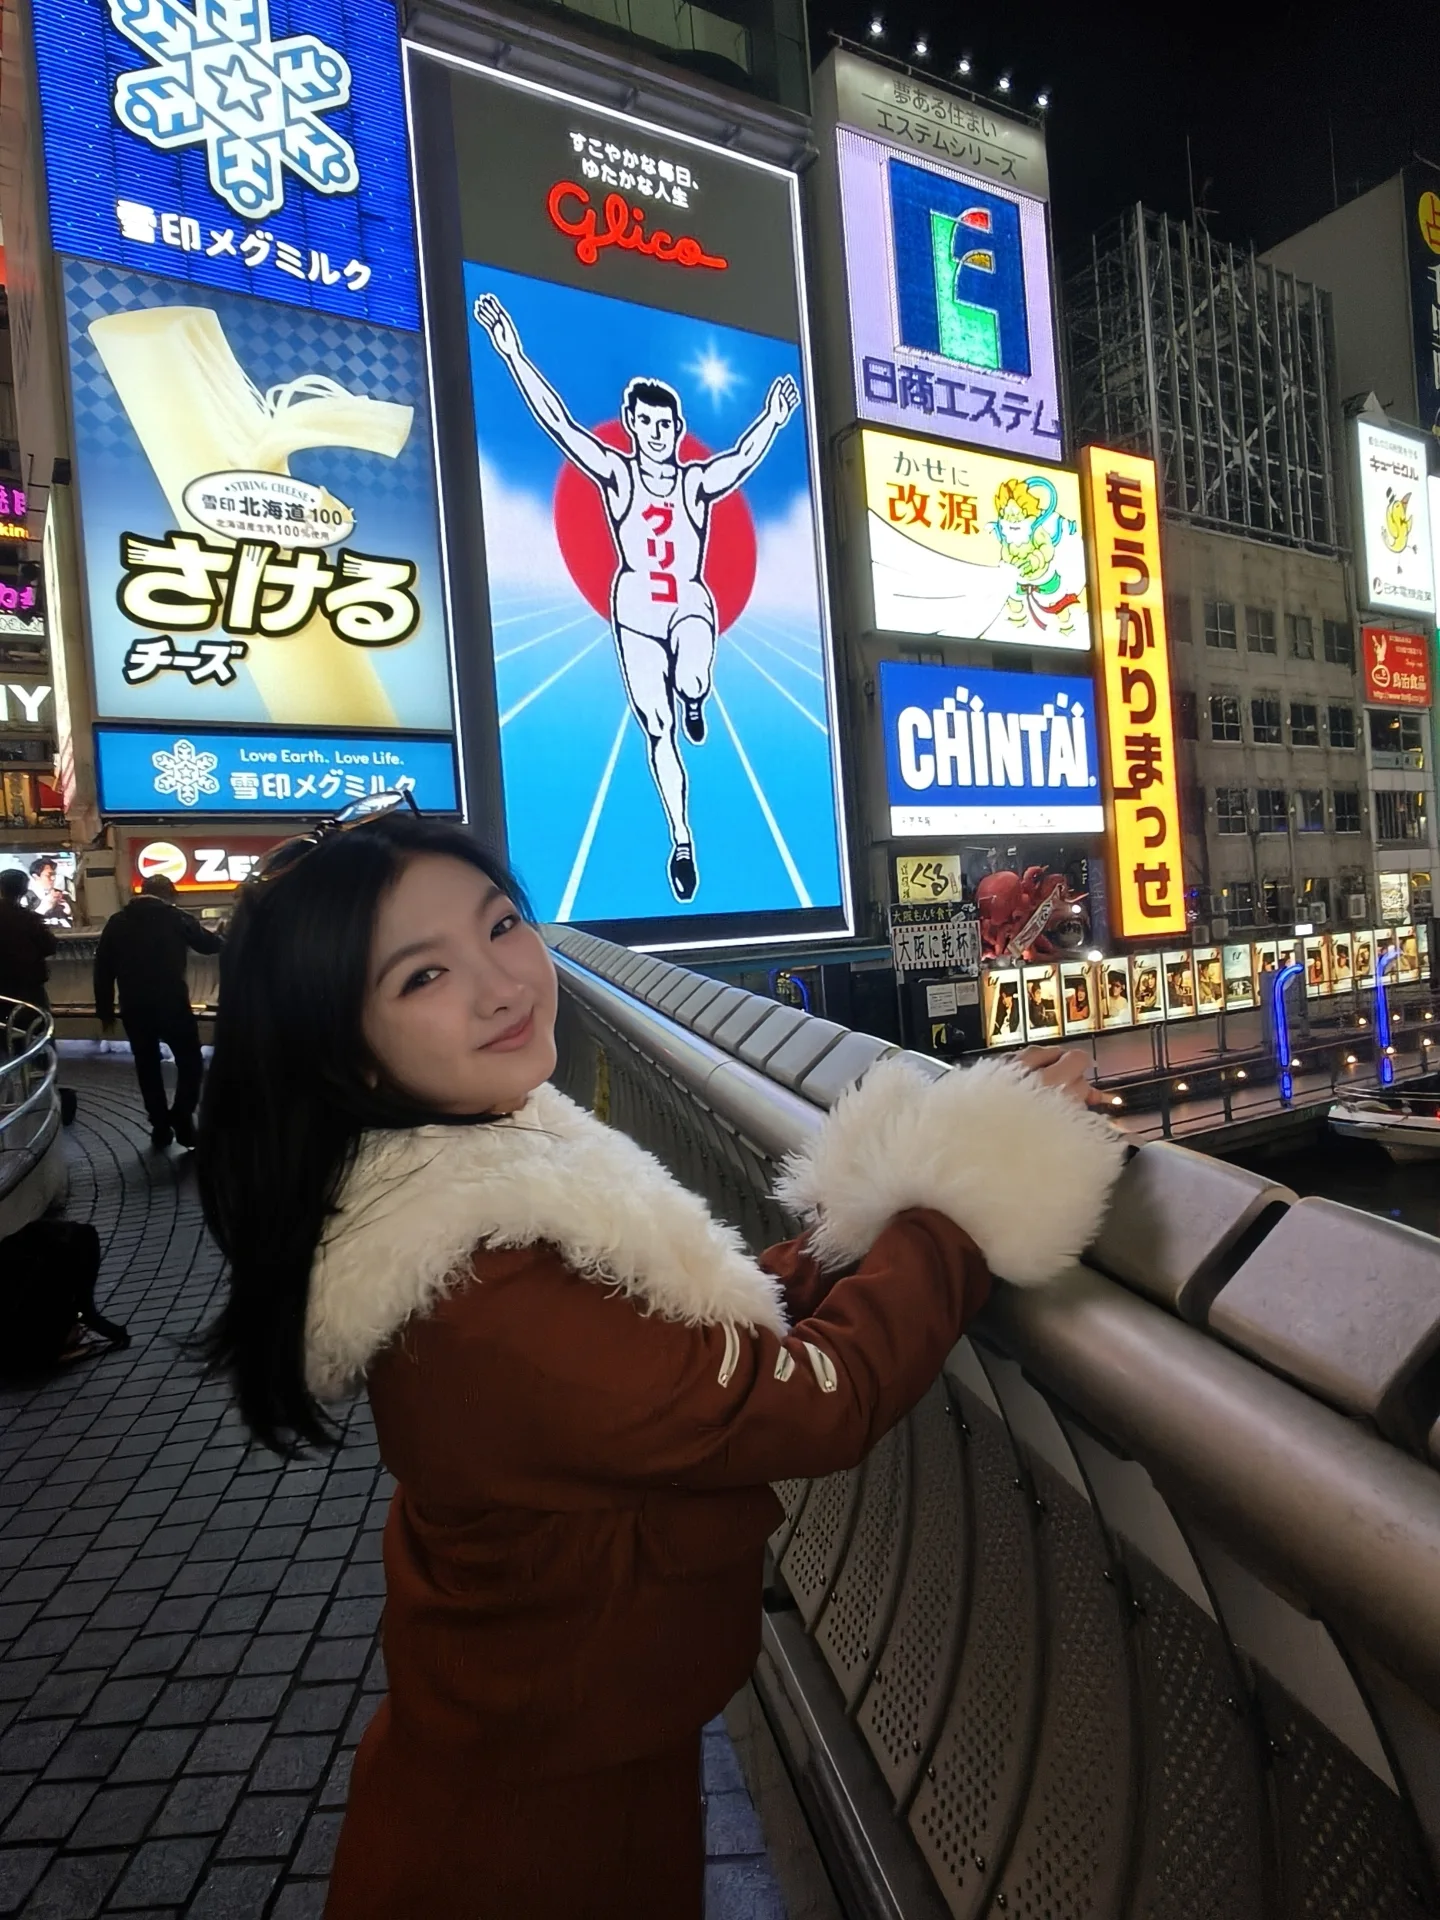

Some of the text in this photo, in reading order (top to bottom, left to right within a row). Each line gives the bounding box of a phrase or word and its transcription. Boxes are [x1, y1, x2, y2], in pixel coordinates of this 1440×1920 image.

[893, 80, 997, 138] 夢ある住まい
[877, 109, 1017, 181] エステムシリーズ
[582, 157, 689, 208] ゆたかな人生
[116, 199, 372, 291] 雪印メグミルク
[548, 181, 728, 269] Glico
[862, 356, 1061, 438] 日商エステム
[230, 480, 309, 502] STRING CHEESE
[894, 451, 971, 487] かせに
[886, 482, 981, 535] 改源
[642, 502, 678, 604] グリコ
[117, 530, 420, 647] さける
[122, 635, 248, 686] チーズ
[1106, 470, 1172, 918] もうかりまっせ
[240, 749, 405, 765] Love Earth. Love Life.
[230, 769, 416, 800] 雪印メグミルク
[910, 863, 949, 896] くくる
[898, 930, 969, 962] 大阪に乾杯
